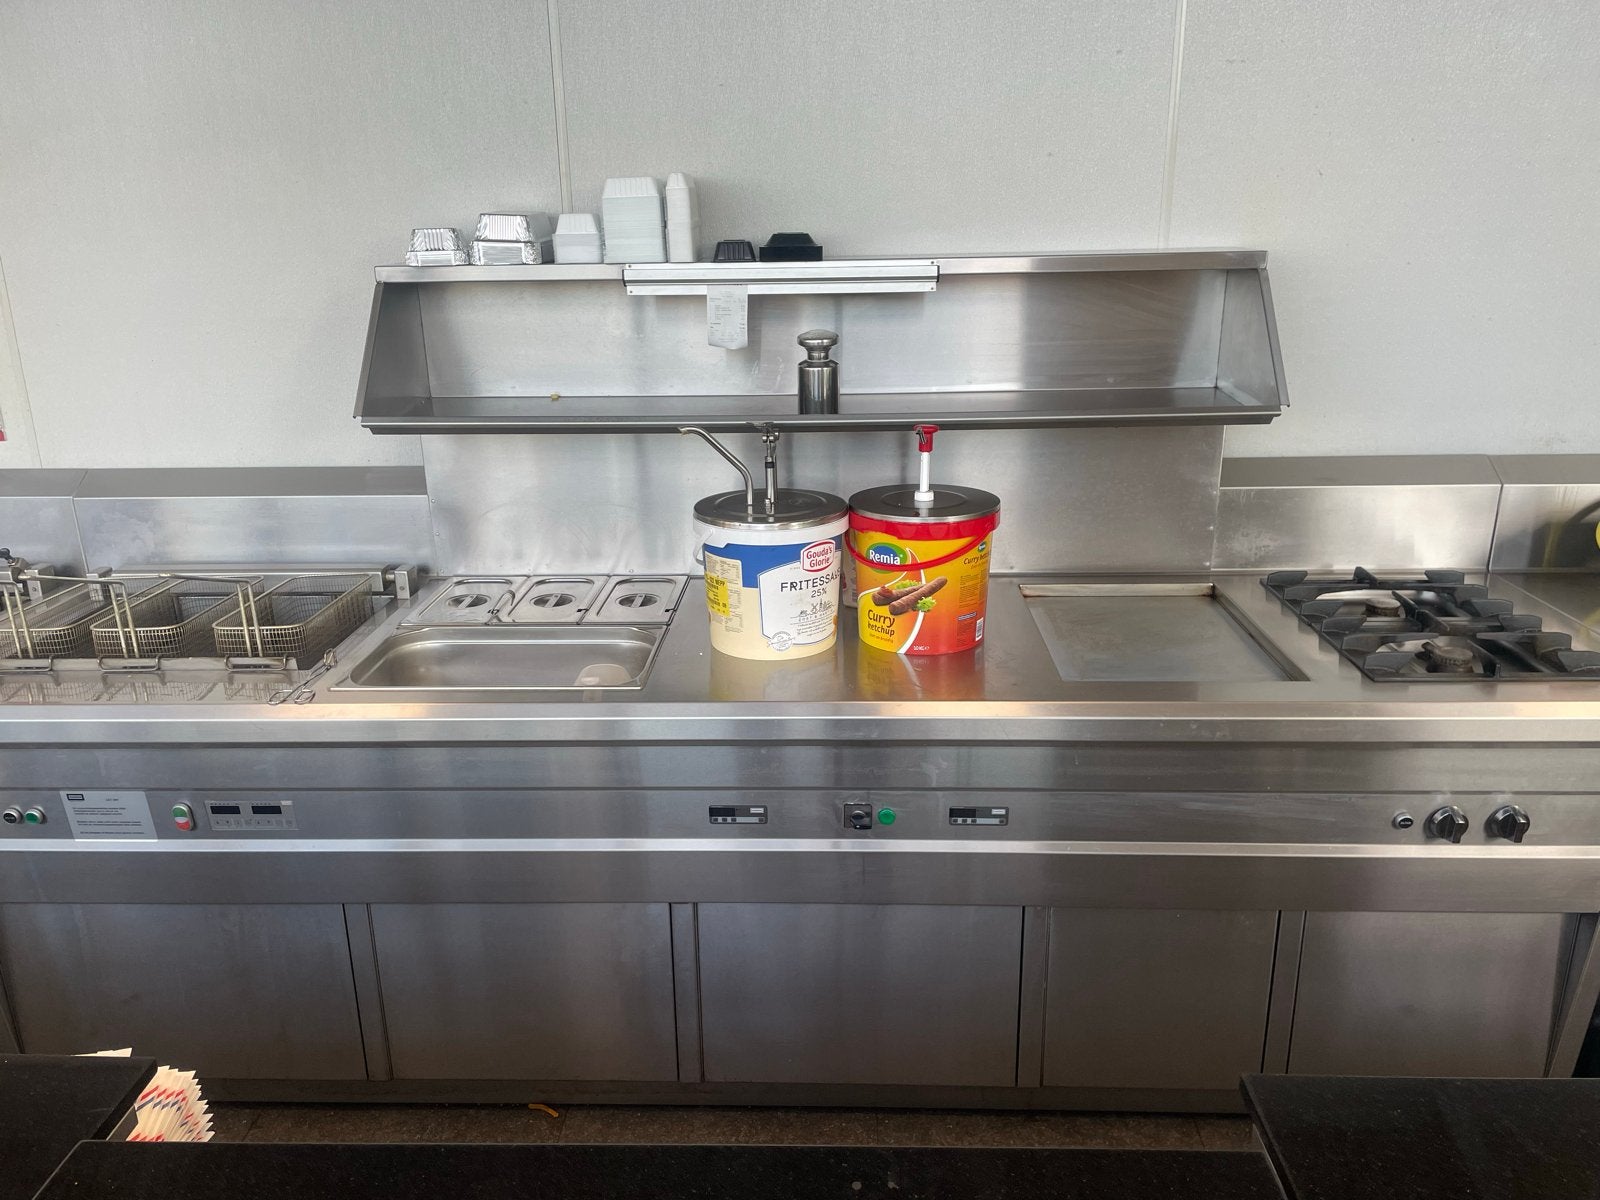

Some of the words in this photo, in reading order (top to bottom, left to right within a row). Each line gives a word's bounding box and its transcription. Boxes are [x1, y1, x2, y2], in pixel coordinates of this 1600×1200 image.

[806, 545, 832, 560] Gouda's
[869, 549, 901, 565] Remia
[809, 556, 830, 568] Glorie
[811, 587, 827, 598] 25%
[867, 609, 896, 628] Curry
[868, 621, 895, 638] ketchup
